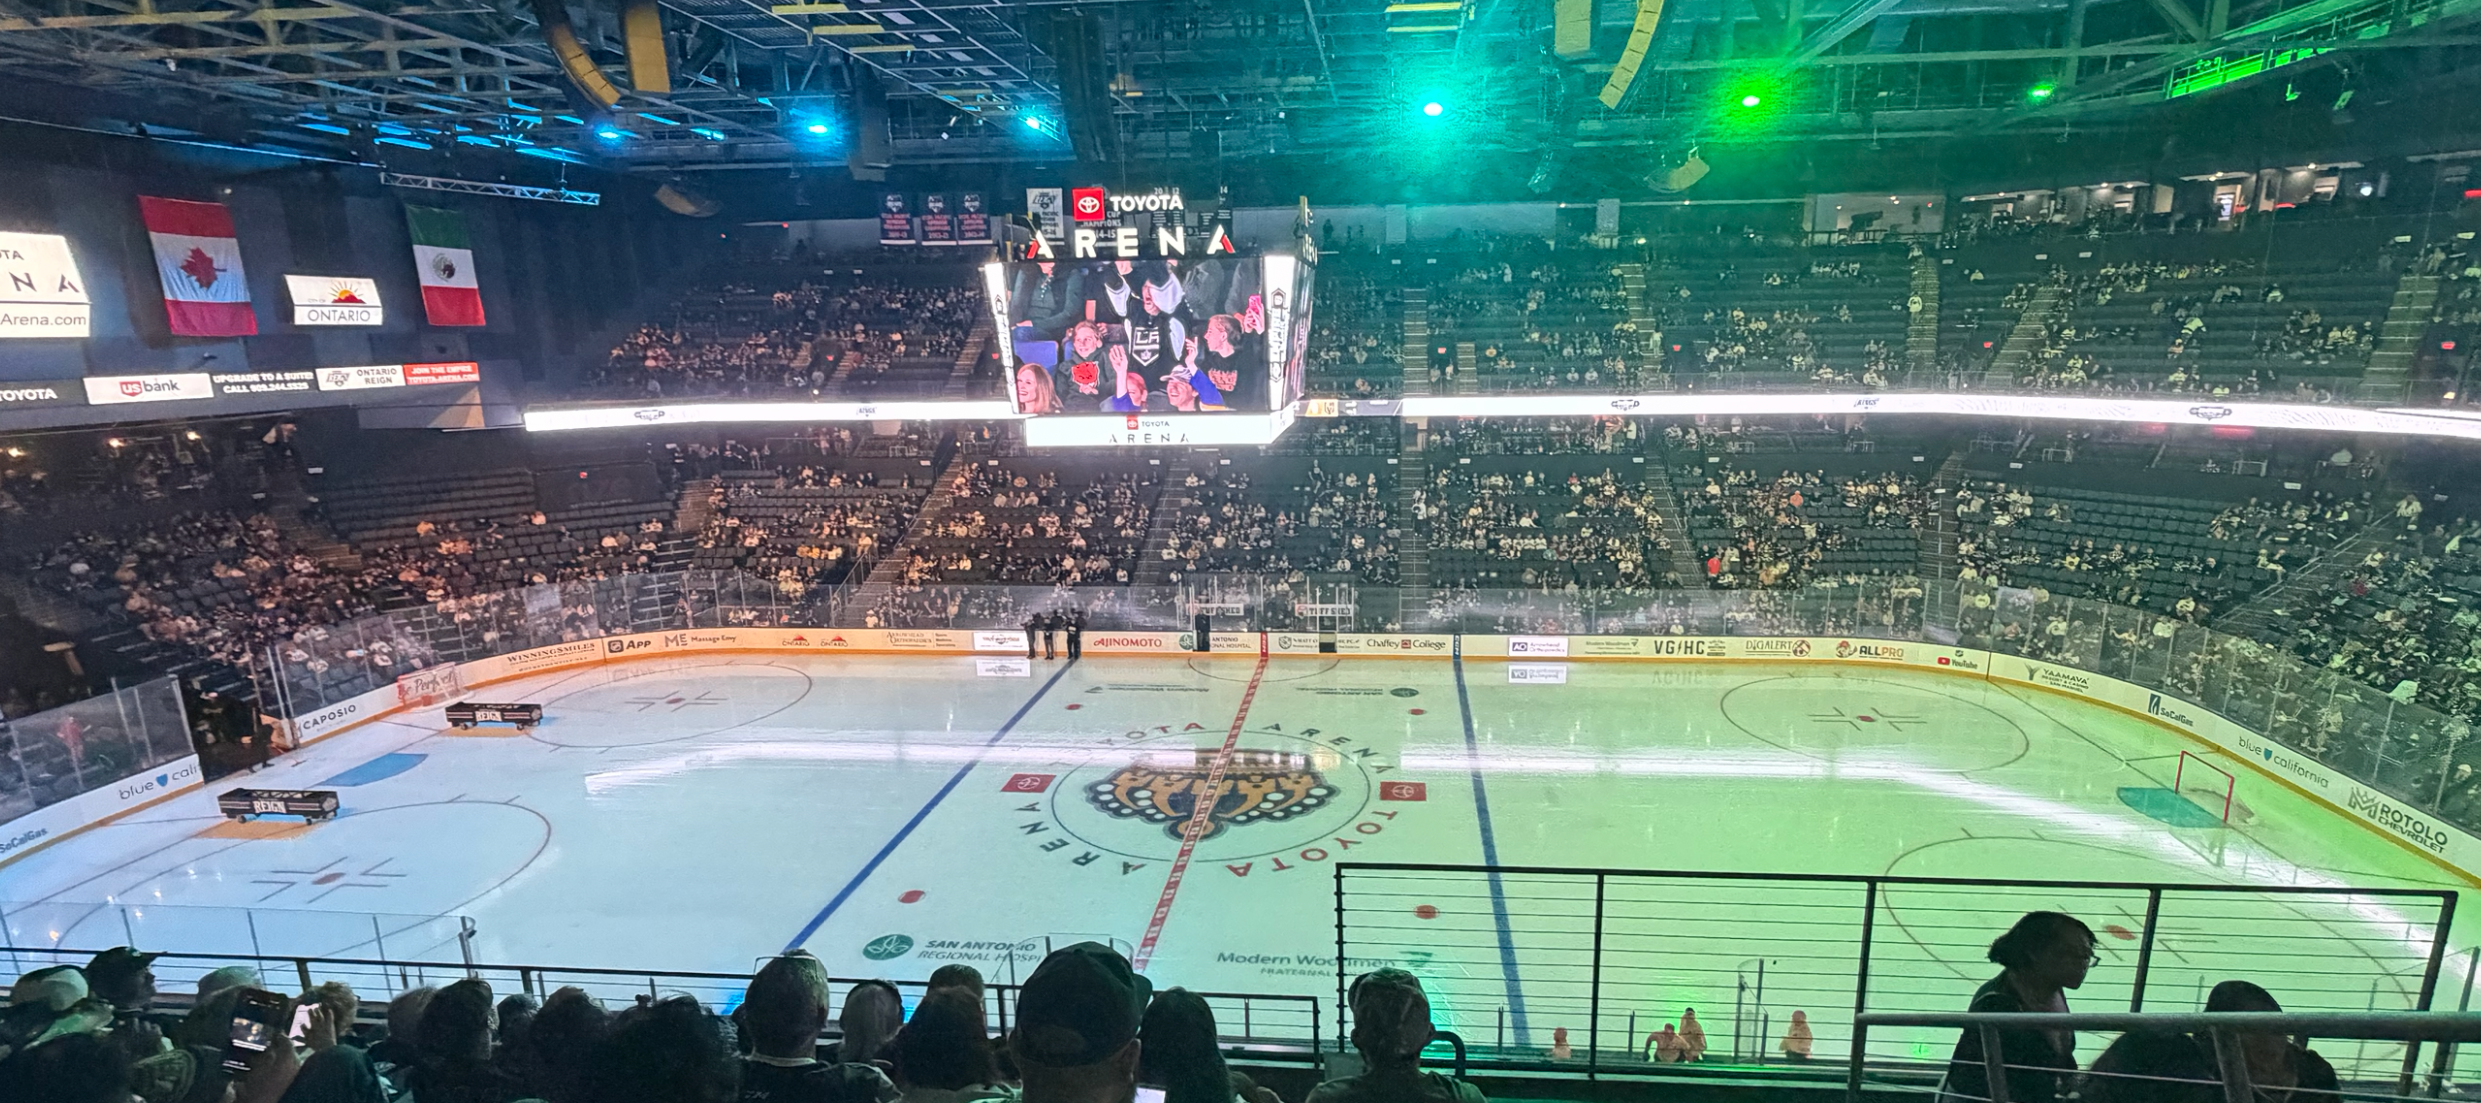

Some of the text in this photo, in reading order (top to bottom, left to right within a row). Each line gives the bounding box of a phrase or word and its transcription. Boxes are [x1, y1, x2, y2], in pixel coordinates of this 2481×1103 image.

[1109, 195, 1184, 212] TOYOTA
[1027, 224, 1235, 259] ARENA
[307, 309, 371, 322] ONTARIO
[212, 374, 260, 384] UPGRADE
[275, 373, 284, 381] A
[356, 368, 398, 377] ONTARIO
[364, 376, 393, 385] REIGN
[1109, 432, 1189, 444] ARENA
[1093, 637, 1163, 648] AJINOMOTO
[1366, 638, 1400, 650] Chaffey
[1412, 639, 1446, 651] College
[1951, 658, 1979, 670] YouTube
[303, 704, 357, 730] CAPOSIO
[2238, 735, 2330, 788] blue california
[119, 779, 155, 800] blue
[252, 800, 287, 814] REIGN
[2380, 803, 2448, 846] ROTOLO
[2378, 815, 2445, 853] CHEVROLET
[924, 940, 959, 949] SAN
[917, 951, 1042, 963] REGIONAL HOSPI
[1216, 952, 1292, 966] Modern
